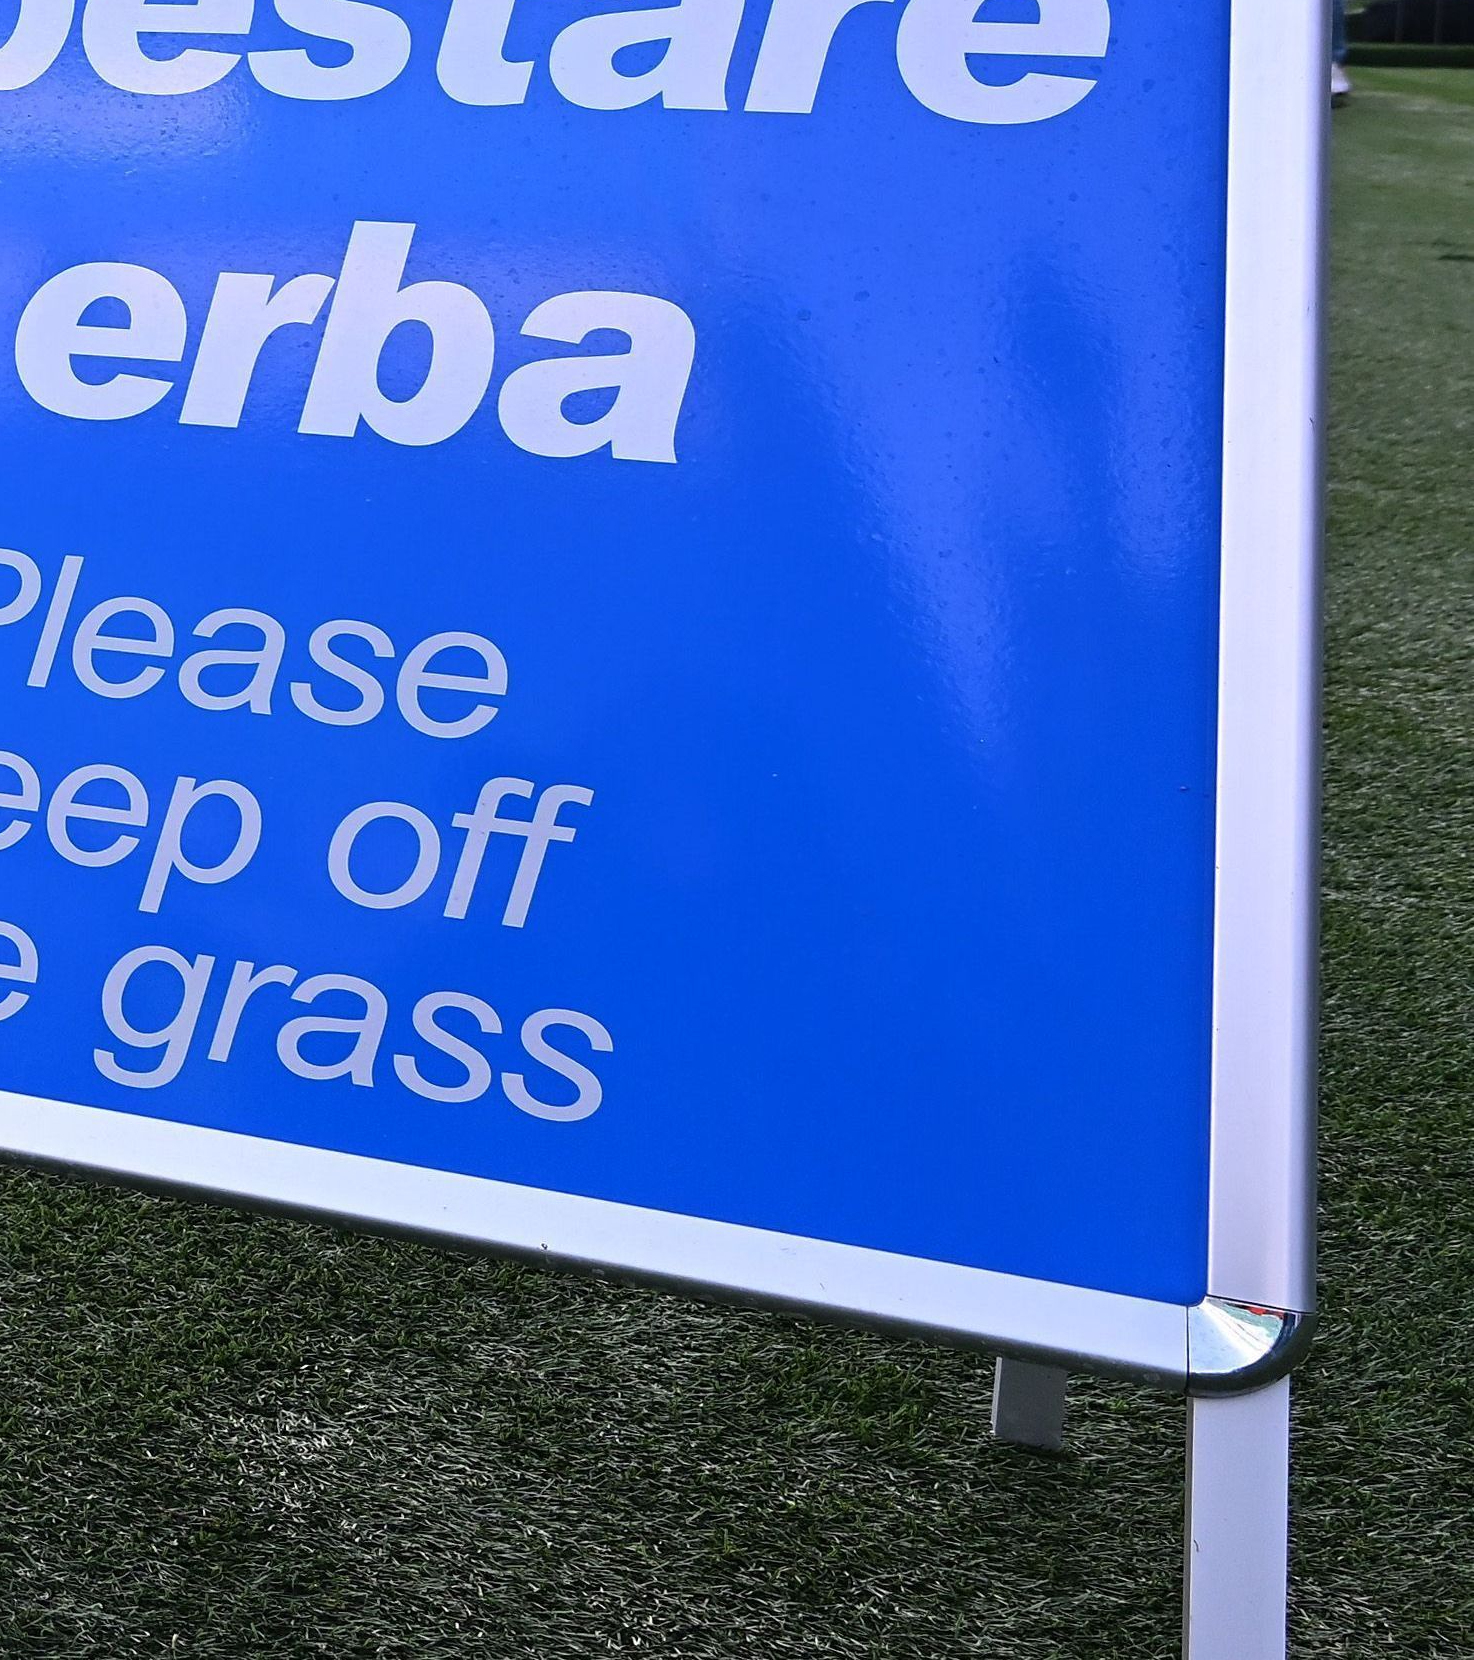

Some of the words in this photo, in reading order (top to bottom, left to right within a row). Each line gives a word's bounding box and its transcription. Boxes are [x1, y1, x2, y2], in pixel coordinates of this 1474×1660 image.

[13, 220, 697, 464] erba
[328, 777, 594, 929] off
[93, 945, 614, 1123] grass
